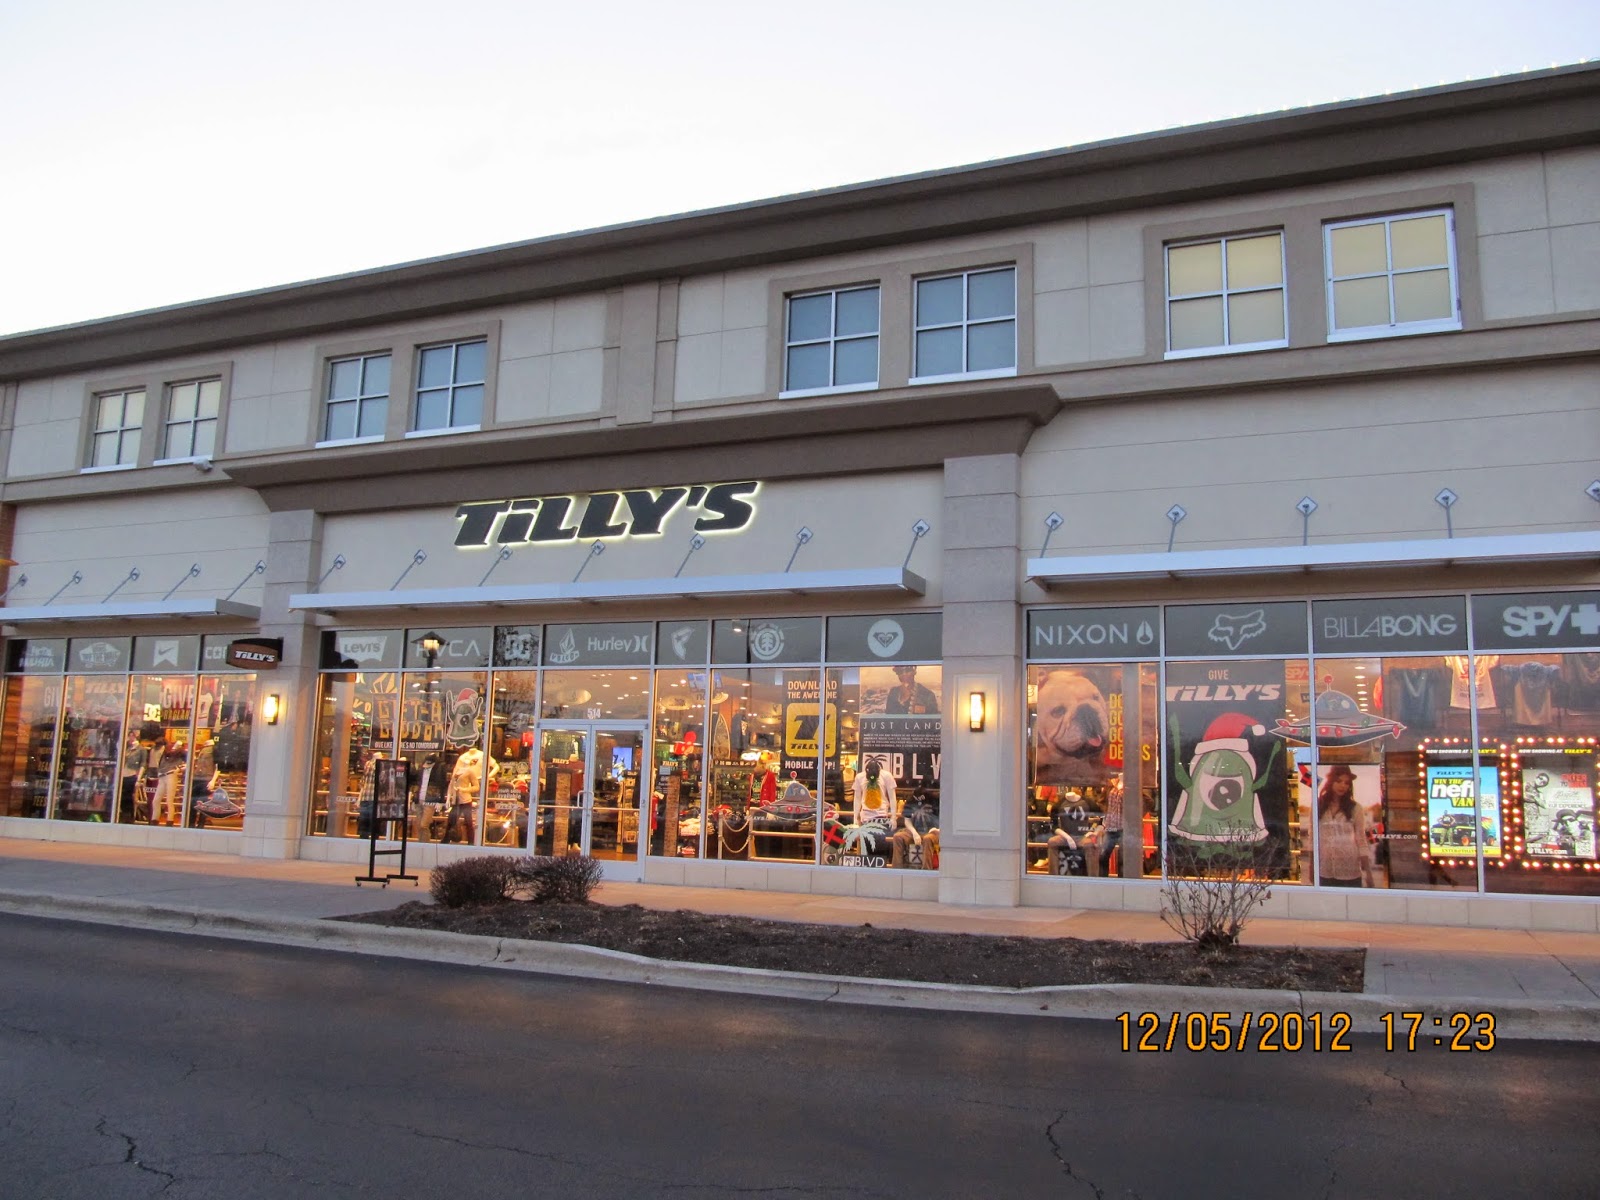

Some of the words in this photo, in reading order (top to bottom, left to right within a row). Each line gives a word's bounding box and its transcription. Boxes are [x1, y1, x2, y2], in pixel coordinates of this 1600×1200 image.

[454, 481, 762, 547] TiLLY'S
[1323, 614, 1457, 638] BILLABONG
[1035, 623, 1128, 646] NIXON
[587, 636, 632, 652] Hurley
[1208, 670, 1229, 681] GIVE
[787, 681, 838, 691] DOWNLAD
[787, 691, 801, 699] THE
[802, 691, 838, 699] AWEME
[587, 708, 601, 719] 514
[863, 722, 894, 730] JUST
[1109, 744, 1151, 761] DES
[784, 760, 814, 769] MOBILE
[817, 761, 836, 770] PP!
[855, 857, 885, 868] BLVD
